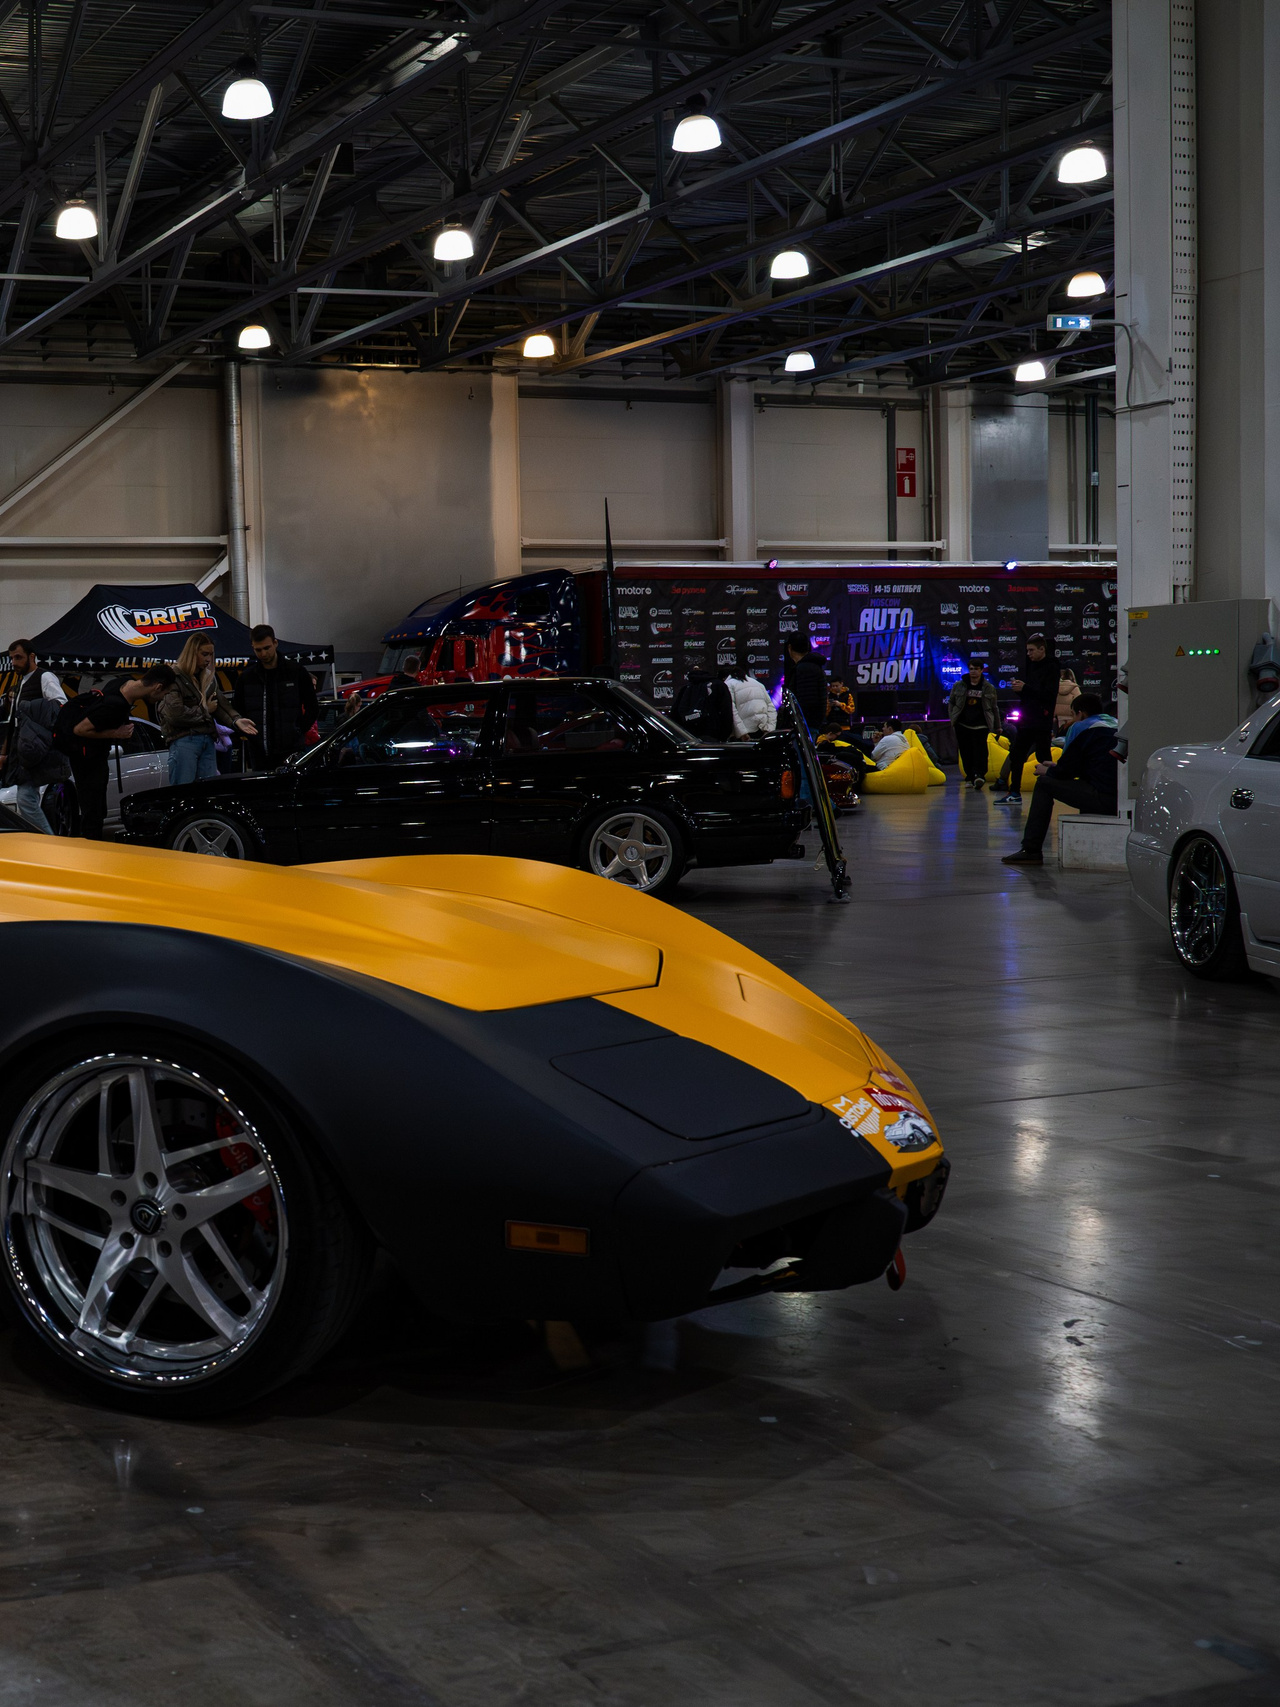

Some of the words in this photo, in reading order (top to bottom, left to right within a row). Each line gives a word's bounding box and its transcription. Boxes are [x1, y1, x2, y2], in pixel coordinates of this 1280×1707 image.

[786, 584, 809, 592] DRIFT
[874, 584, 891, 593] 14-15
[870, 598, 901, 607] MOSCOW
[133, 603, 208, 626] DRIFT
[859, 607, 914, 632] AUTO
[176, 619, 206, 630] EXPO
[847, 629, 926, 662] TUNING
[115, 657, 142, 669] ALL
[215, 657, 251, 669] DRIFT
[856, 659, 920, 685] SHOW
[839, 1097, 873, 1130] CUSTOMS
